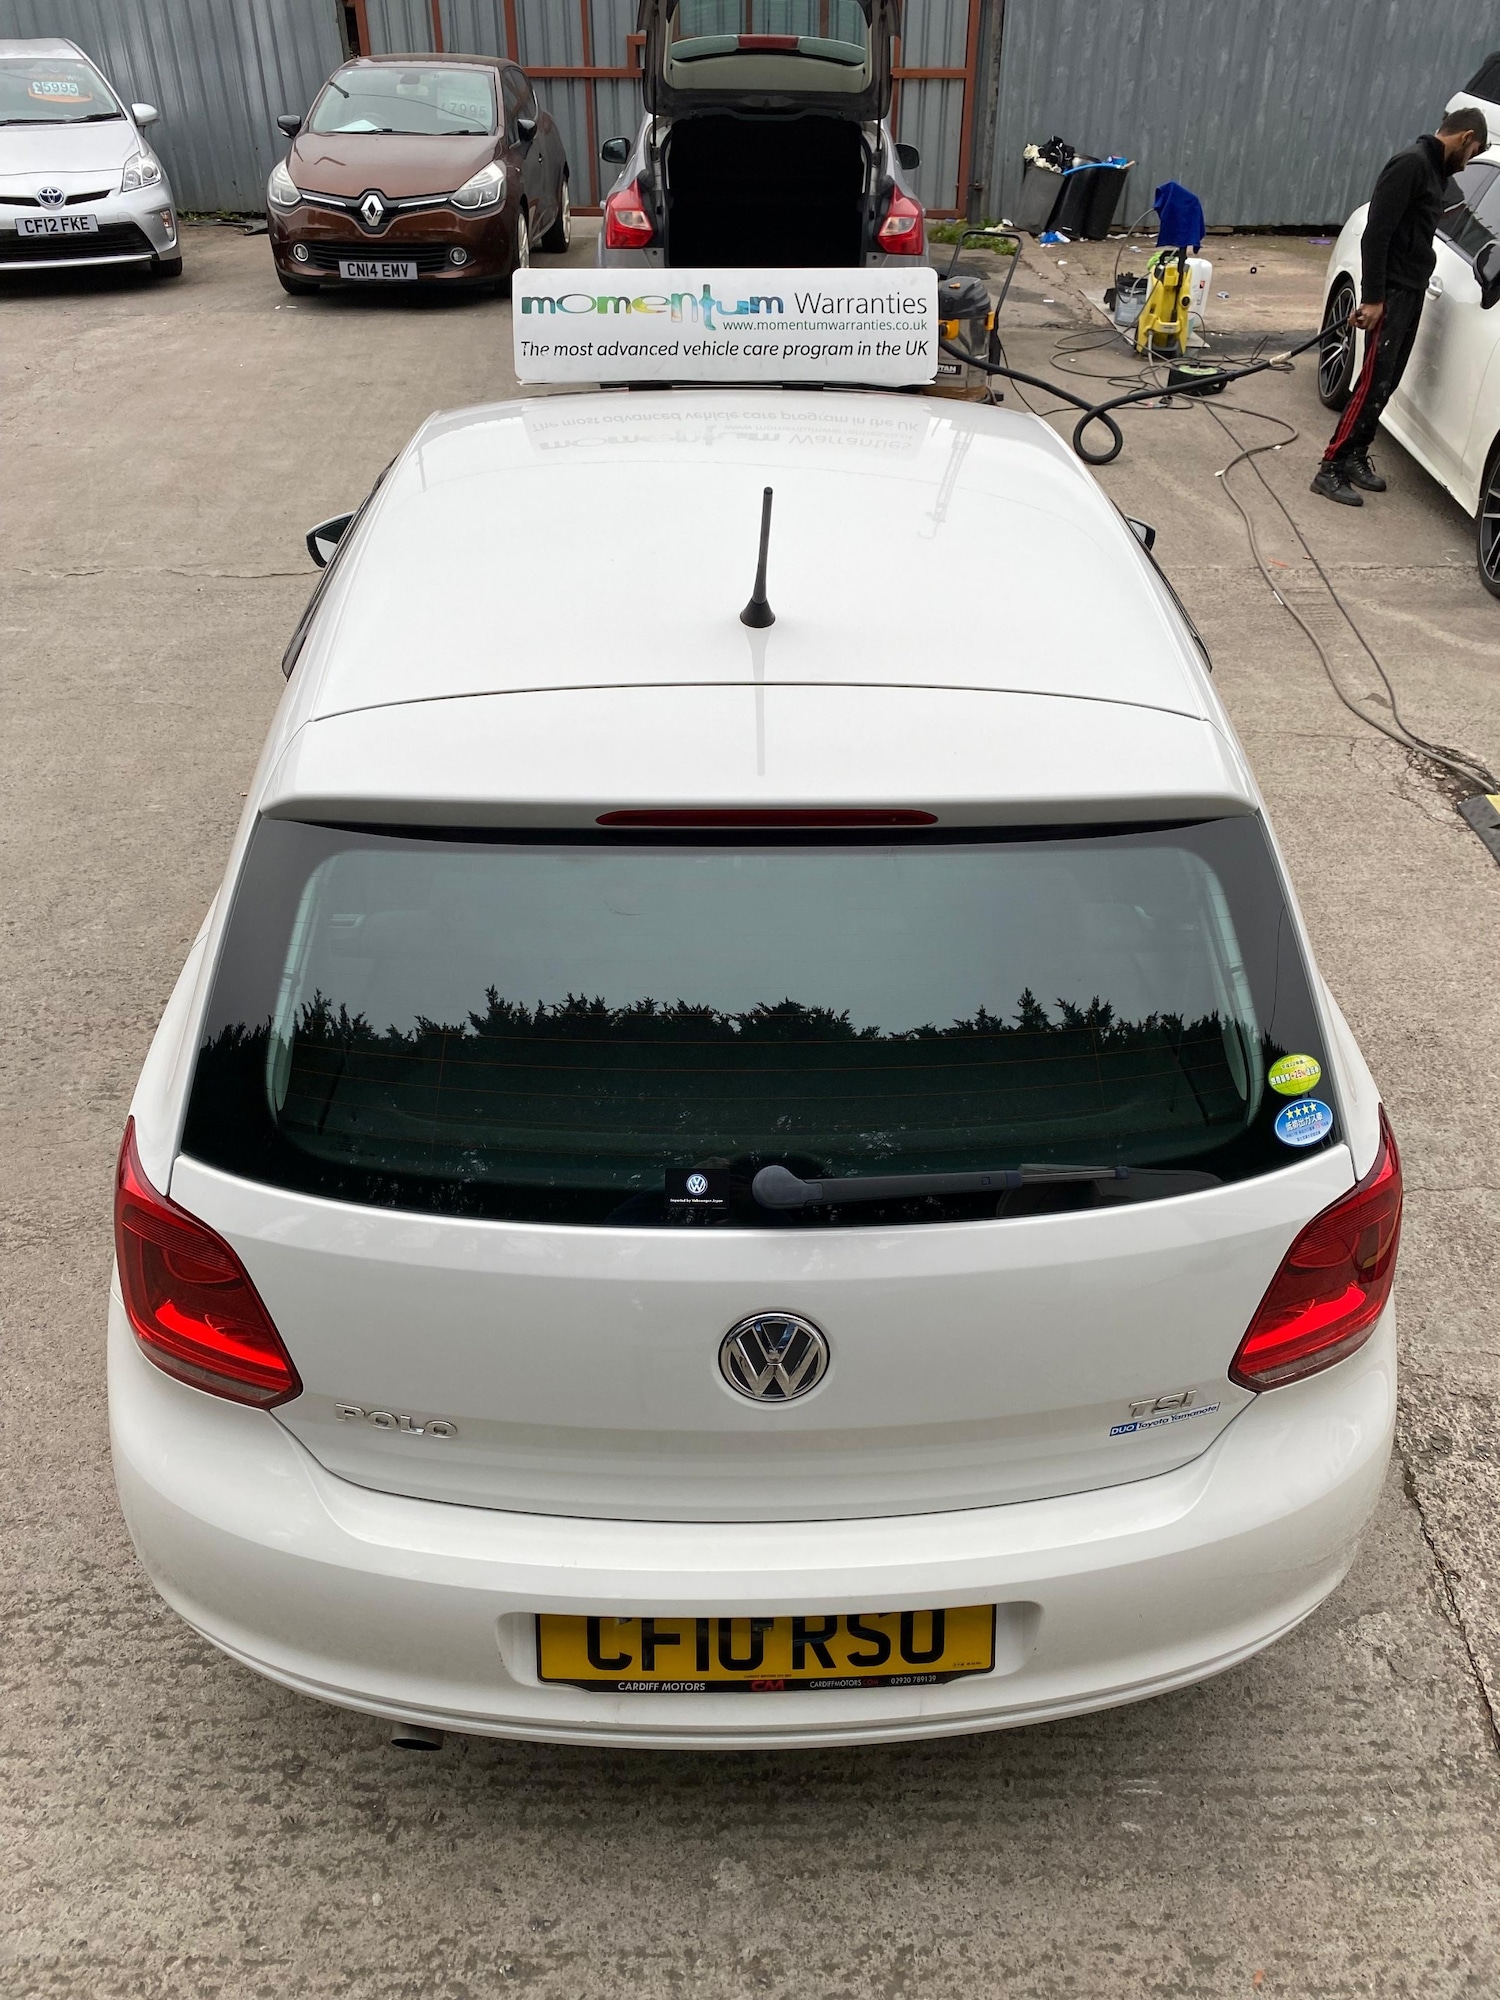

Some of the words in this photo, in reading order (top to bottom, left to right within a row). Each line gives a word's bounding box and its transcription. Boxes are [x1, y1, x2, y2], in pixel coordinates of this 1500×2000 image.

[24, 218, 59, 233] CF12
[60, 216, 90, 231] FKE
[347, 263, 378, 277] CN14
[381, 263, 408, 278] EMV
[521, 284, 784, 331] momentum
[794, 292, 928, 314] Warranties
[723, 320, 928, 331] www.momentumwarranties.co.uk
[521, 341, 550, 356] The
[554, 342, 593, 356] most
[597, 341, 679, 356] advanced
[683, 340, 739, 356] vehicle
[743, 344, 779, 356] care
[782, 344, 854, 360] program
[857, 341, 872, 355] in
[875, 341, 901, 356] the
[905, 341, 929, 356] UK
[1129, 1389, 1197, 1419] TSI
[335, 1403, 458, 1439] POLO
[1111, 1424, 1136, 1435] DUO
[618, 1682, 659, 1691] CARDIFF
[661, 1682, 706, 1691] MOTORS
